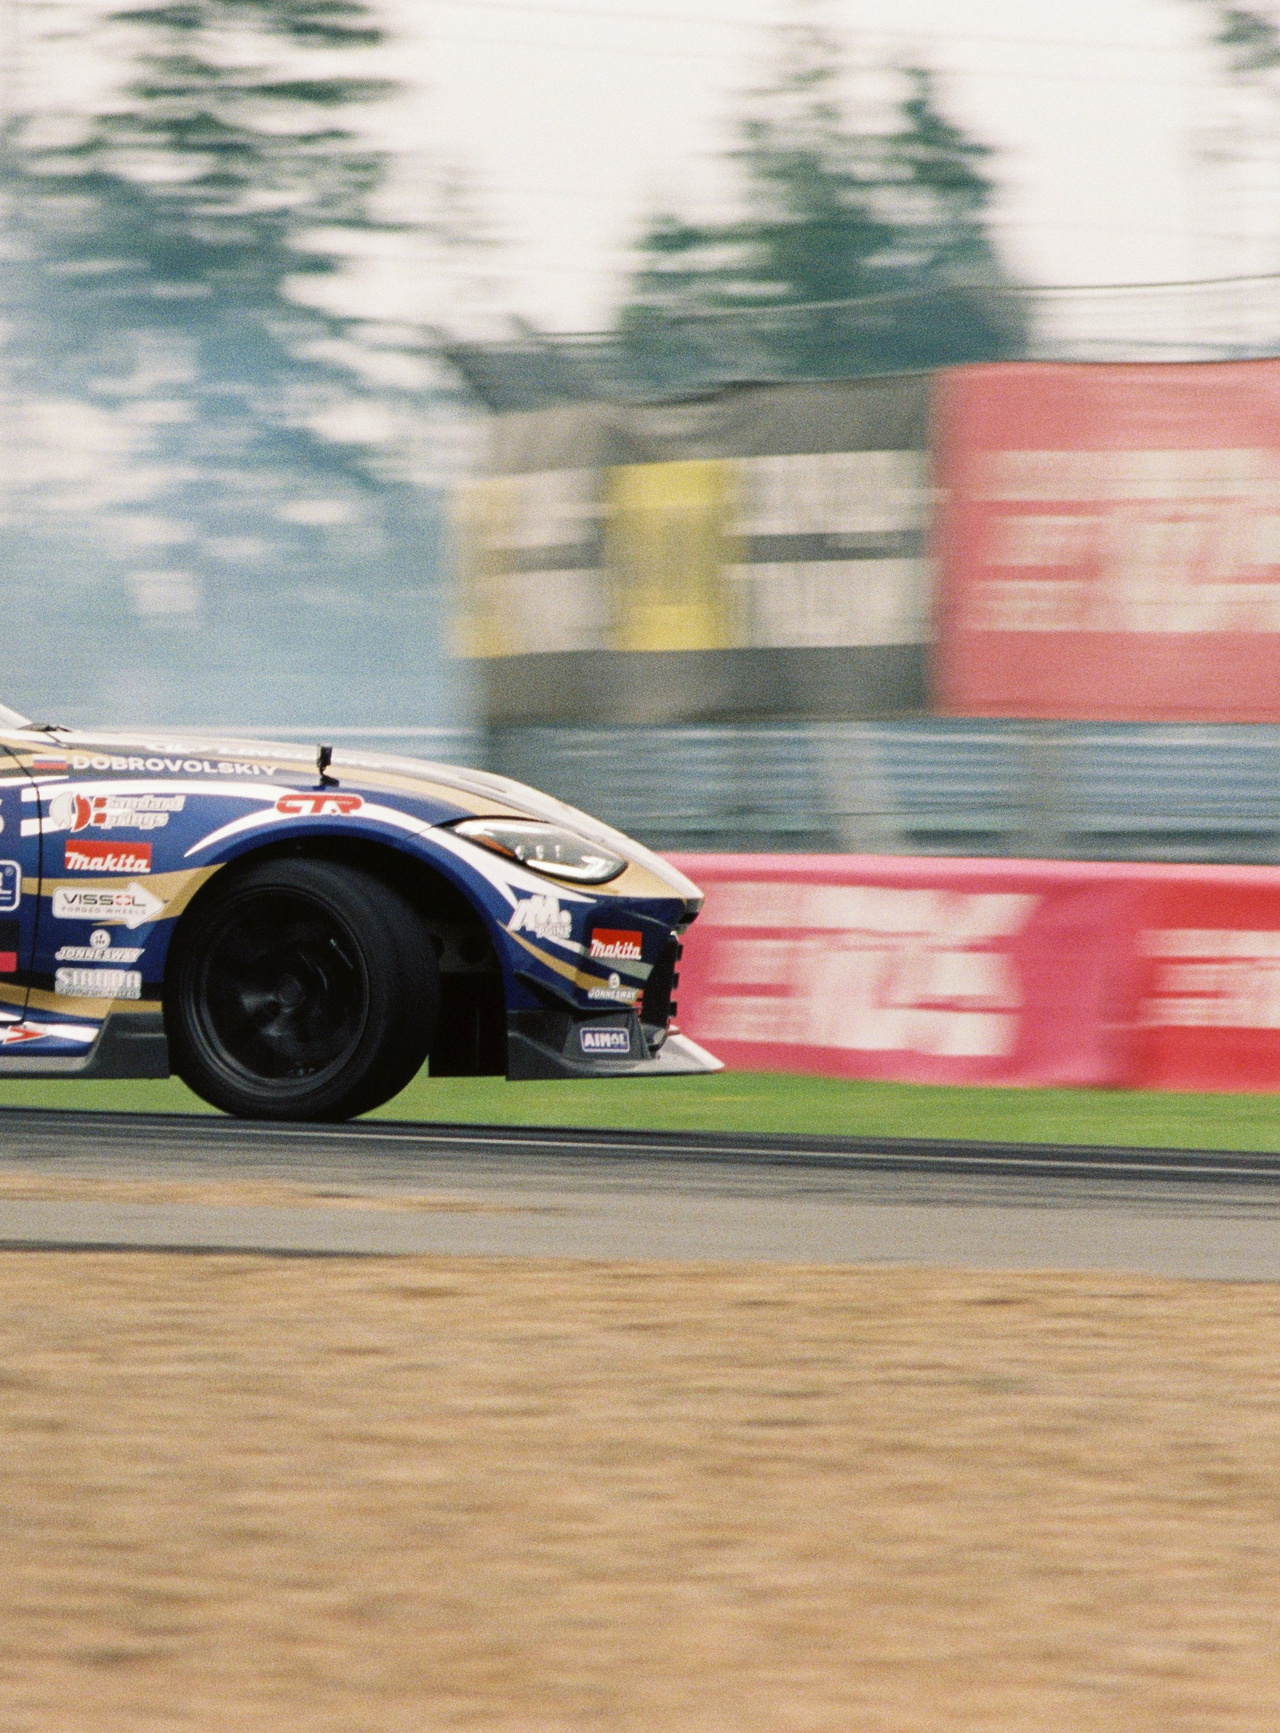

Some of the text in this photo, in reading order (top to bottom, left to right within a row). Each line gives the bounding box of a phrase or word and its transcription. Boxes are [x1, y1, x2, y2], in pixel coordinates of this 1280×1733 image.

[70, 755, 278, 776] DOBROVOLSKIY
[63, 893, 146, 907] VISSOL
[61, 906, 146, 915] FORGED WHEELS
[55, 946, 145, 963] JONNESWAY
[584, 1032, 628, 1048] AIMOL
